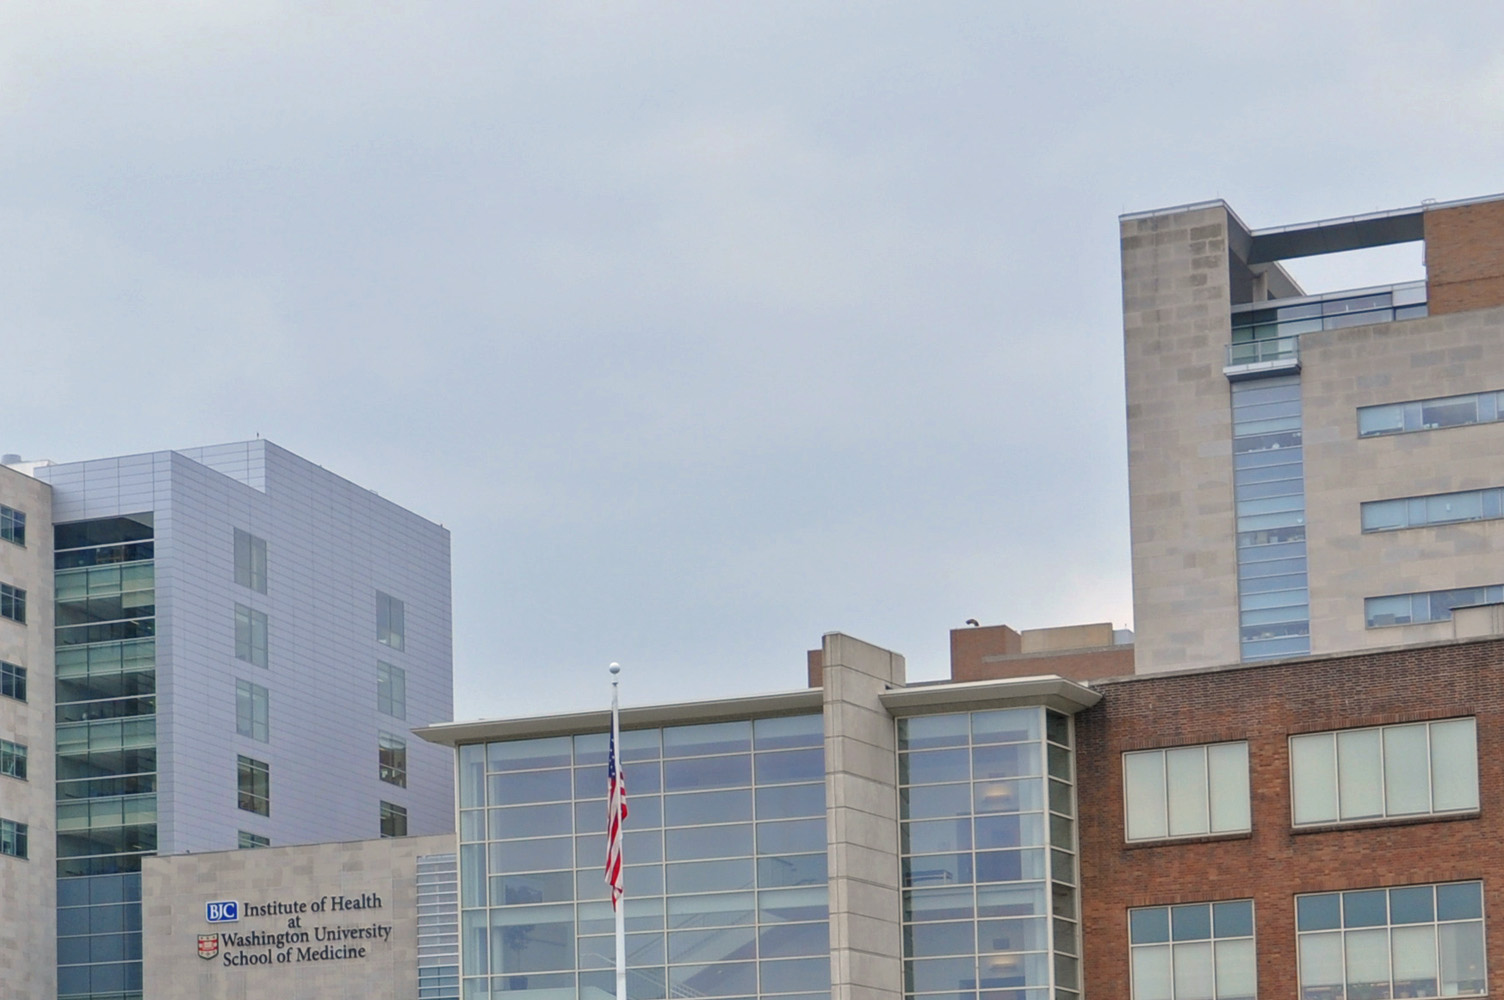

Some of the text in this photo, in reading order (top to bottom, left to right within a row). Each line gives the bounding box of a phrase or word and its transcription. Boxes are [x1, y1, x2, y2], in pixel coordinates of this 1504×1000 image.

[209, 902, 235, 920] BJC
[243, 893, 383, 918] Institute of Health
[287, 916, 302, 929] at
[221, 923, 392, 949] Washington University
[223, 944, 367, 967] School of Medicine
